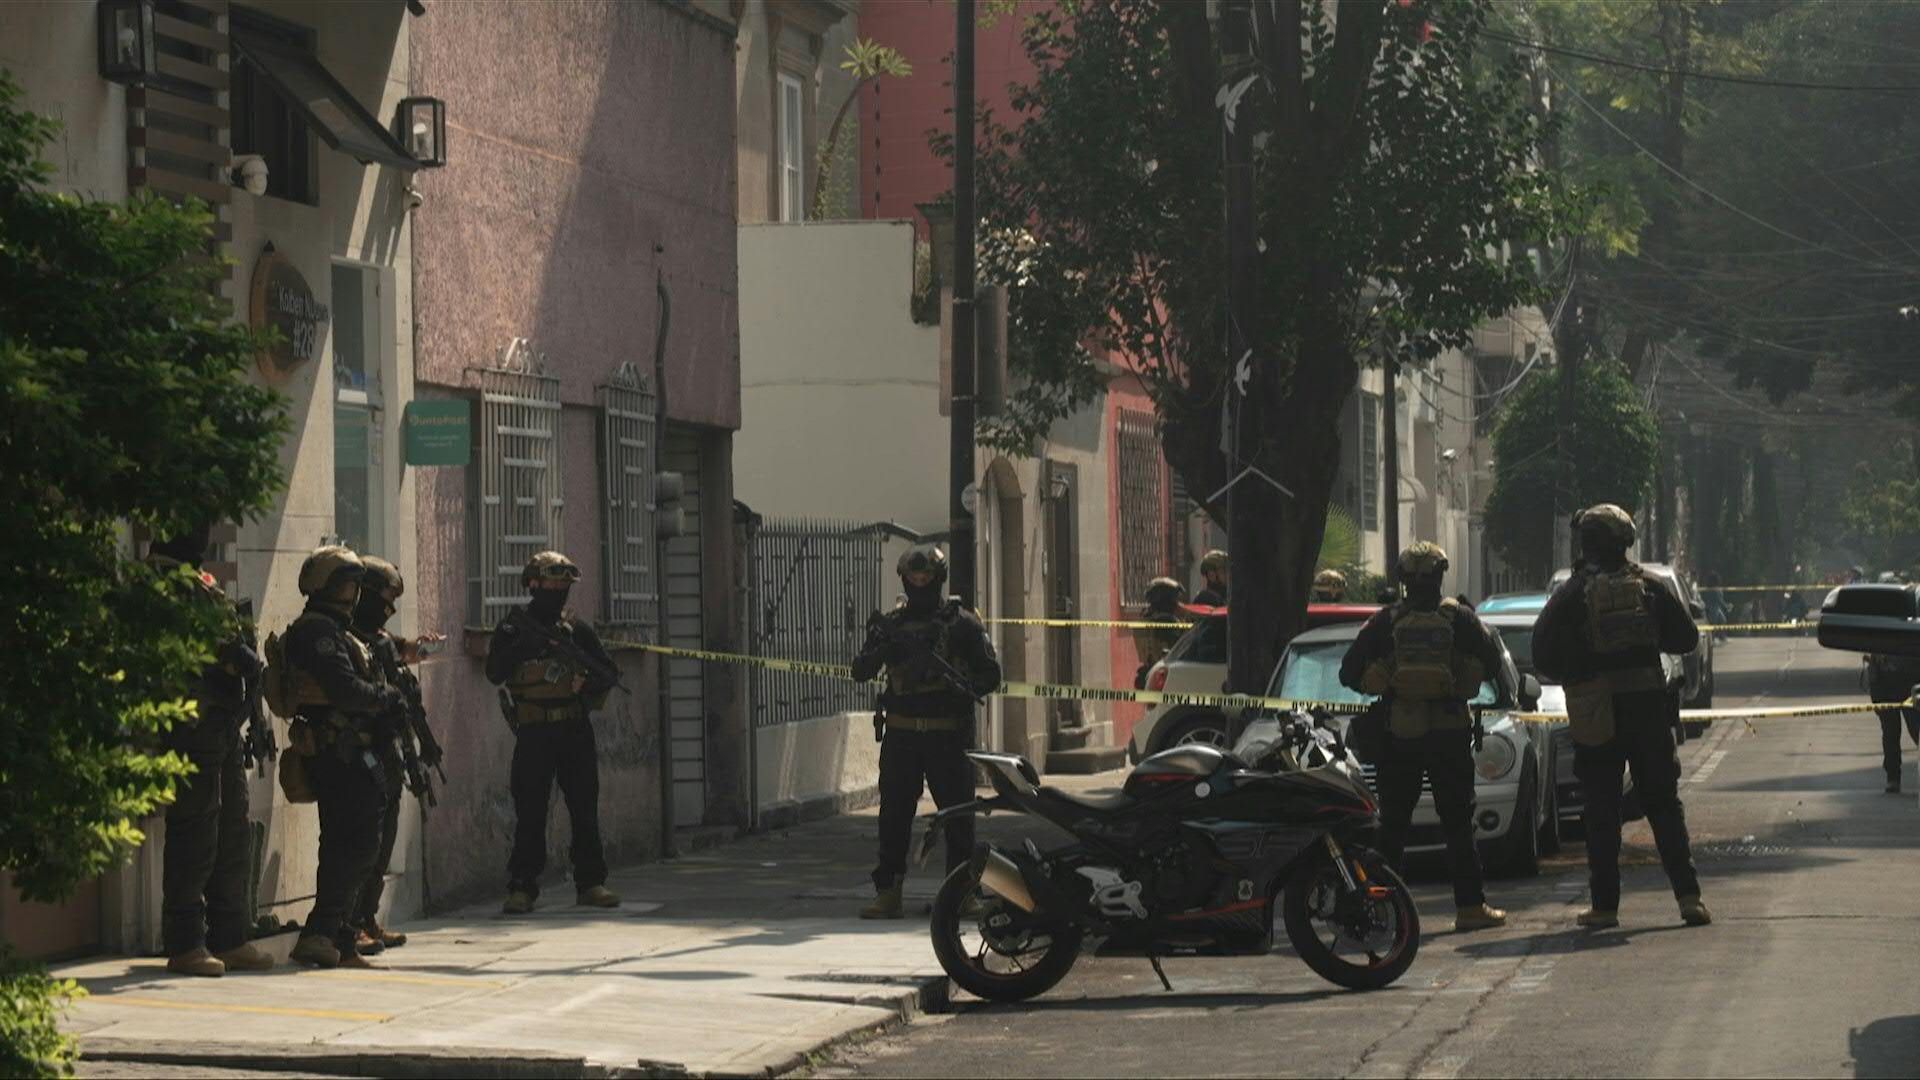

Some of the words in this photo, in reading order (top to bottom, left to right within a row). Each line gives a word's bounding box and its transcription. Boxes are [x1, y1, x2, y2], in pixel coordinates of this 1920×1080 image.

[293, 319, 314, 357] #28
[1034, 685, 1062, 698] PASO
[1067, 687, 1078, 698] EL
[1081, 689, 1136, 702] PROHIBIDO
[1162, 693, 1190, 705] PASO
[1195, 695, 1207, 706] EL
[1210, 697, 1265, 710] PROHIBIDO
